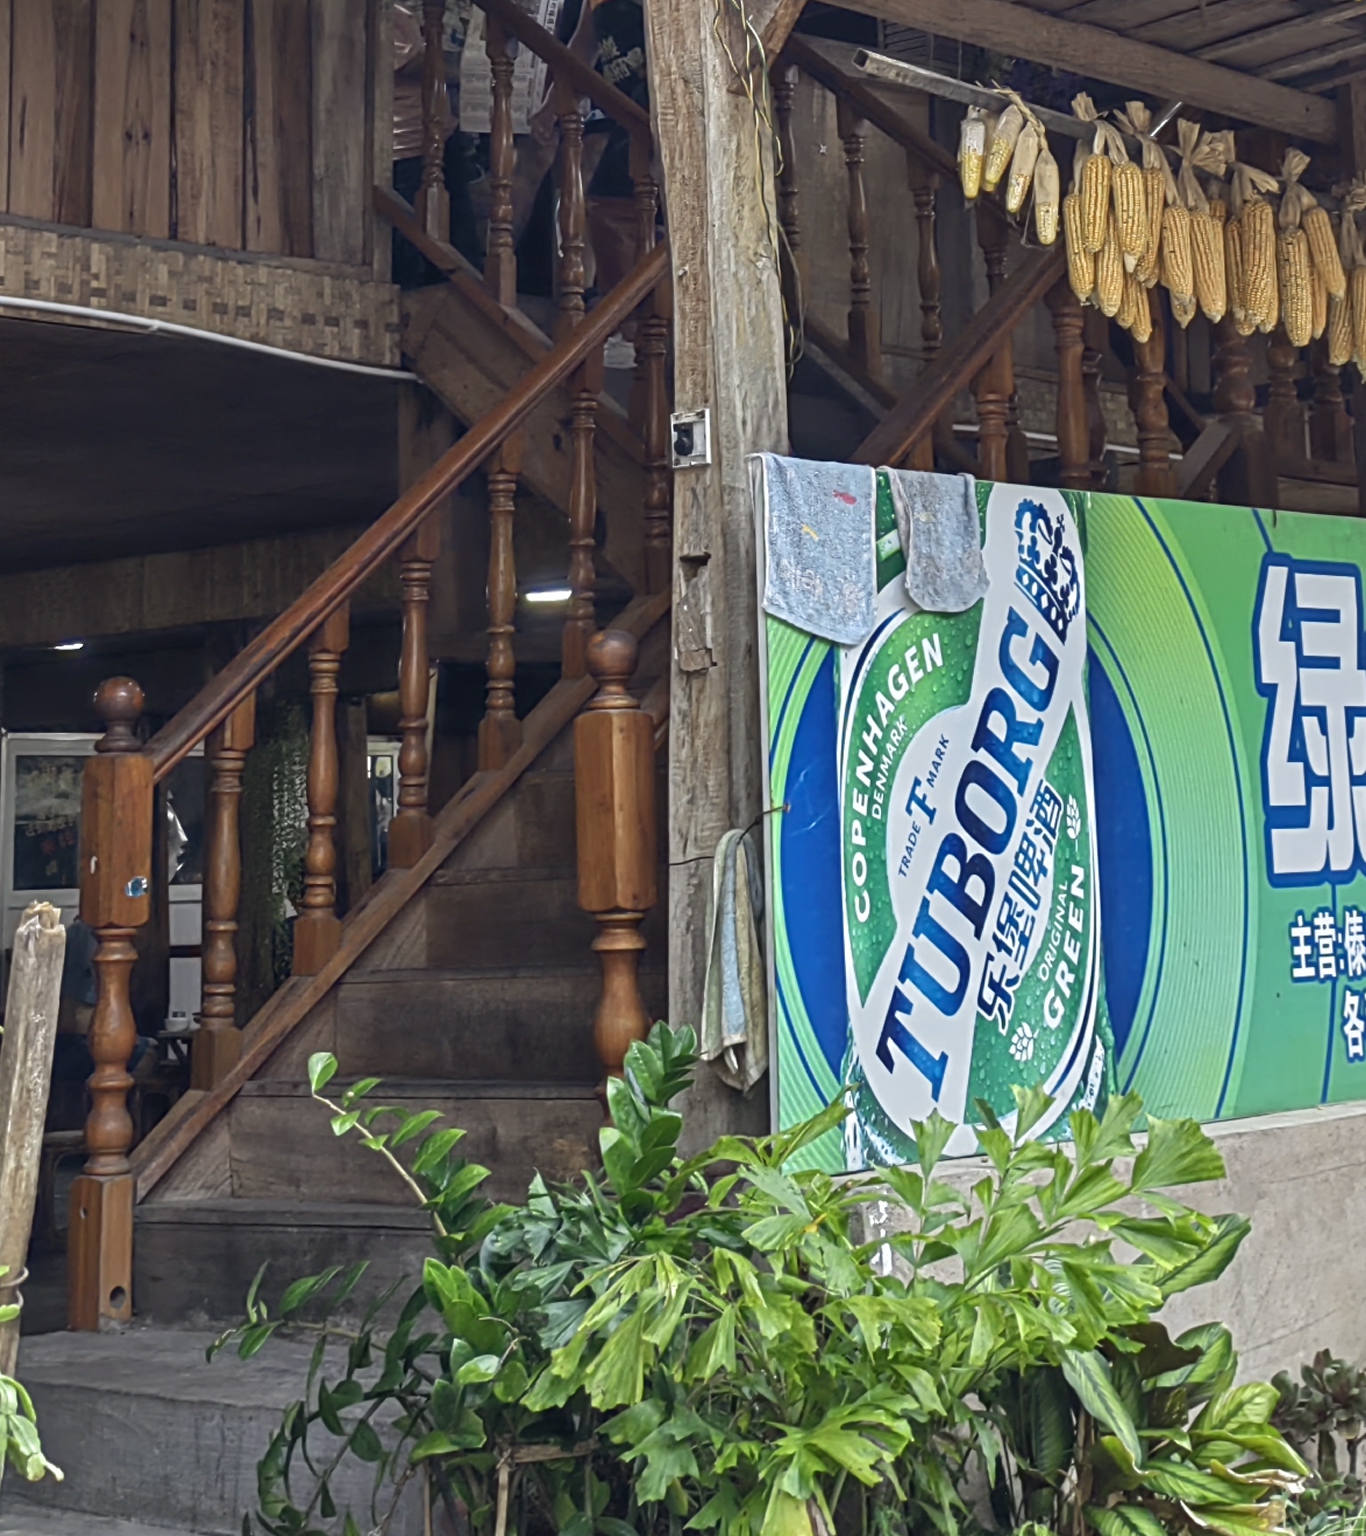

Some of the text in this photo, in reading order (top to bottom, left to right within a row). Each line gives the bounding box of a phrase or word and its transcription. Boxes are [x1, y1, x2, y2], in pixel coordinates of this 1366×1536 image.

[851, 632, 944, 924] COPENHAGEN
[872, 715, 909, 820] DENMARK
[897, 820, 922, 879] TRADE
[926, 733, 951, 789] MARK
[875, 605, 1061, 1102] TUBORG
[978, 778, 1063, 1034] 乐堡啤酒
[1038, 879, 1069, 982] ORIGINAL
[1043, 864, 1086, 1030] GREEN
